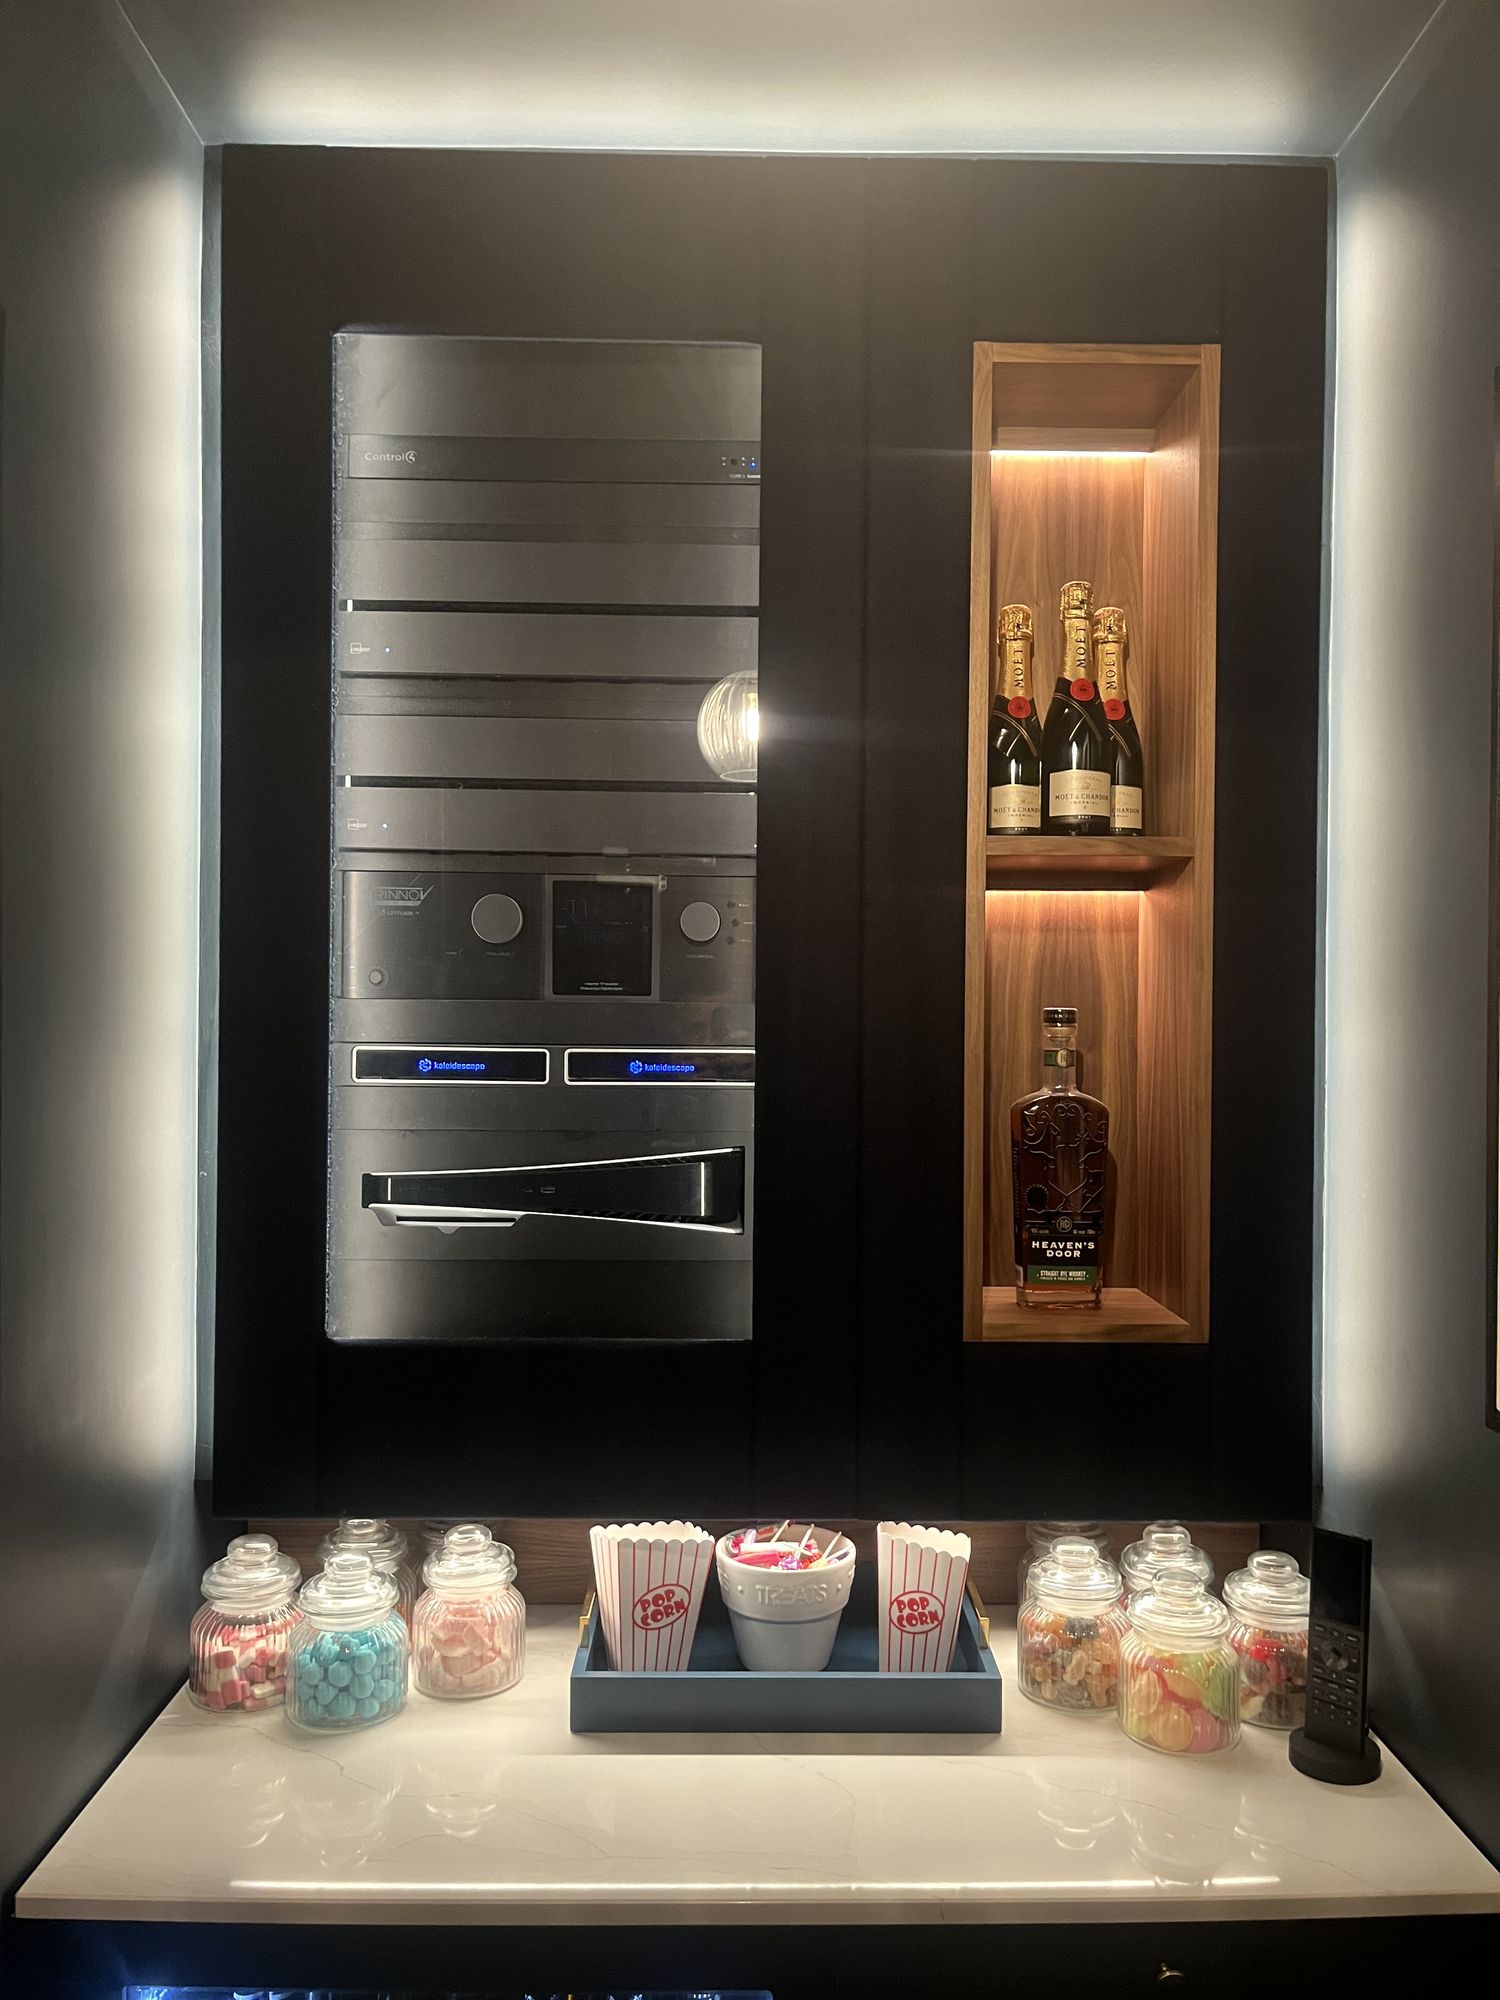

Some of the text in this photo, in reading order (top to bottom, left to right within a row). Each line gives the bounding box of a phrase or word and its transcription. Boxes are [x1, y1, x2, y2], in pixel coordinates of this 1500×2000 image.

[434, 1062, 486, 1072] kaleidescape
[644, 1063, 695, 1073] kaleidescape
[1031, 1241, 1095, 1249] HEAVEN'S
[639, 1588, 676, 1613] POP
[755, 1583, 829, 1606] TREATS
[640, 1597, 687, 1627] CORN
[896, 1596, 930, 1614] POP
[896, 1609, 941, 1628] CORN
